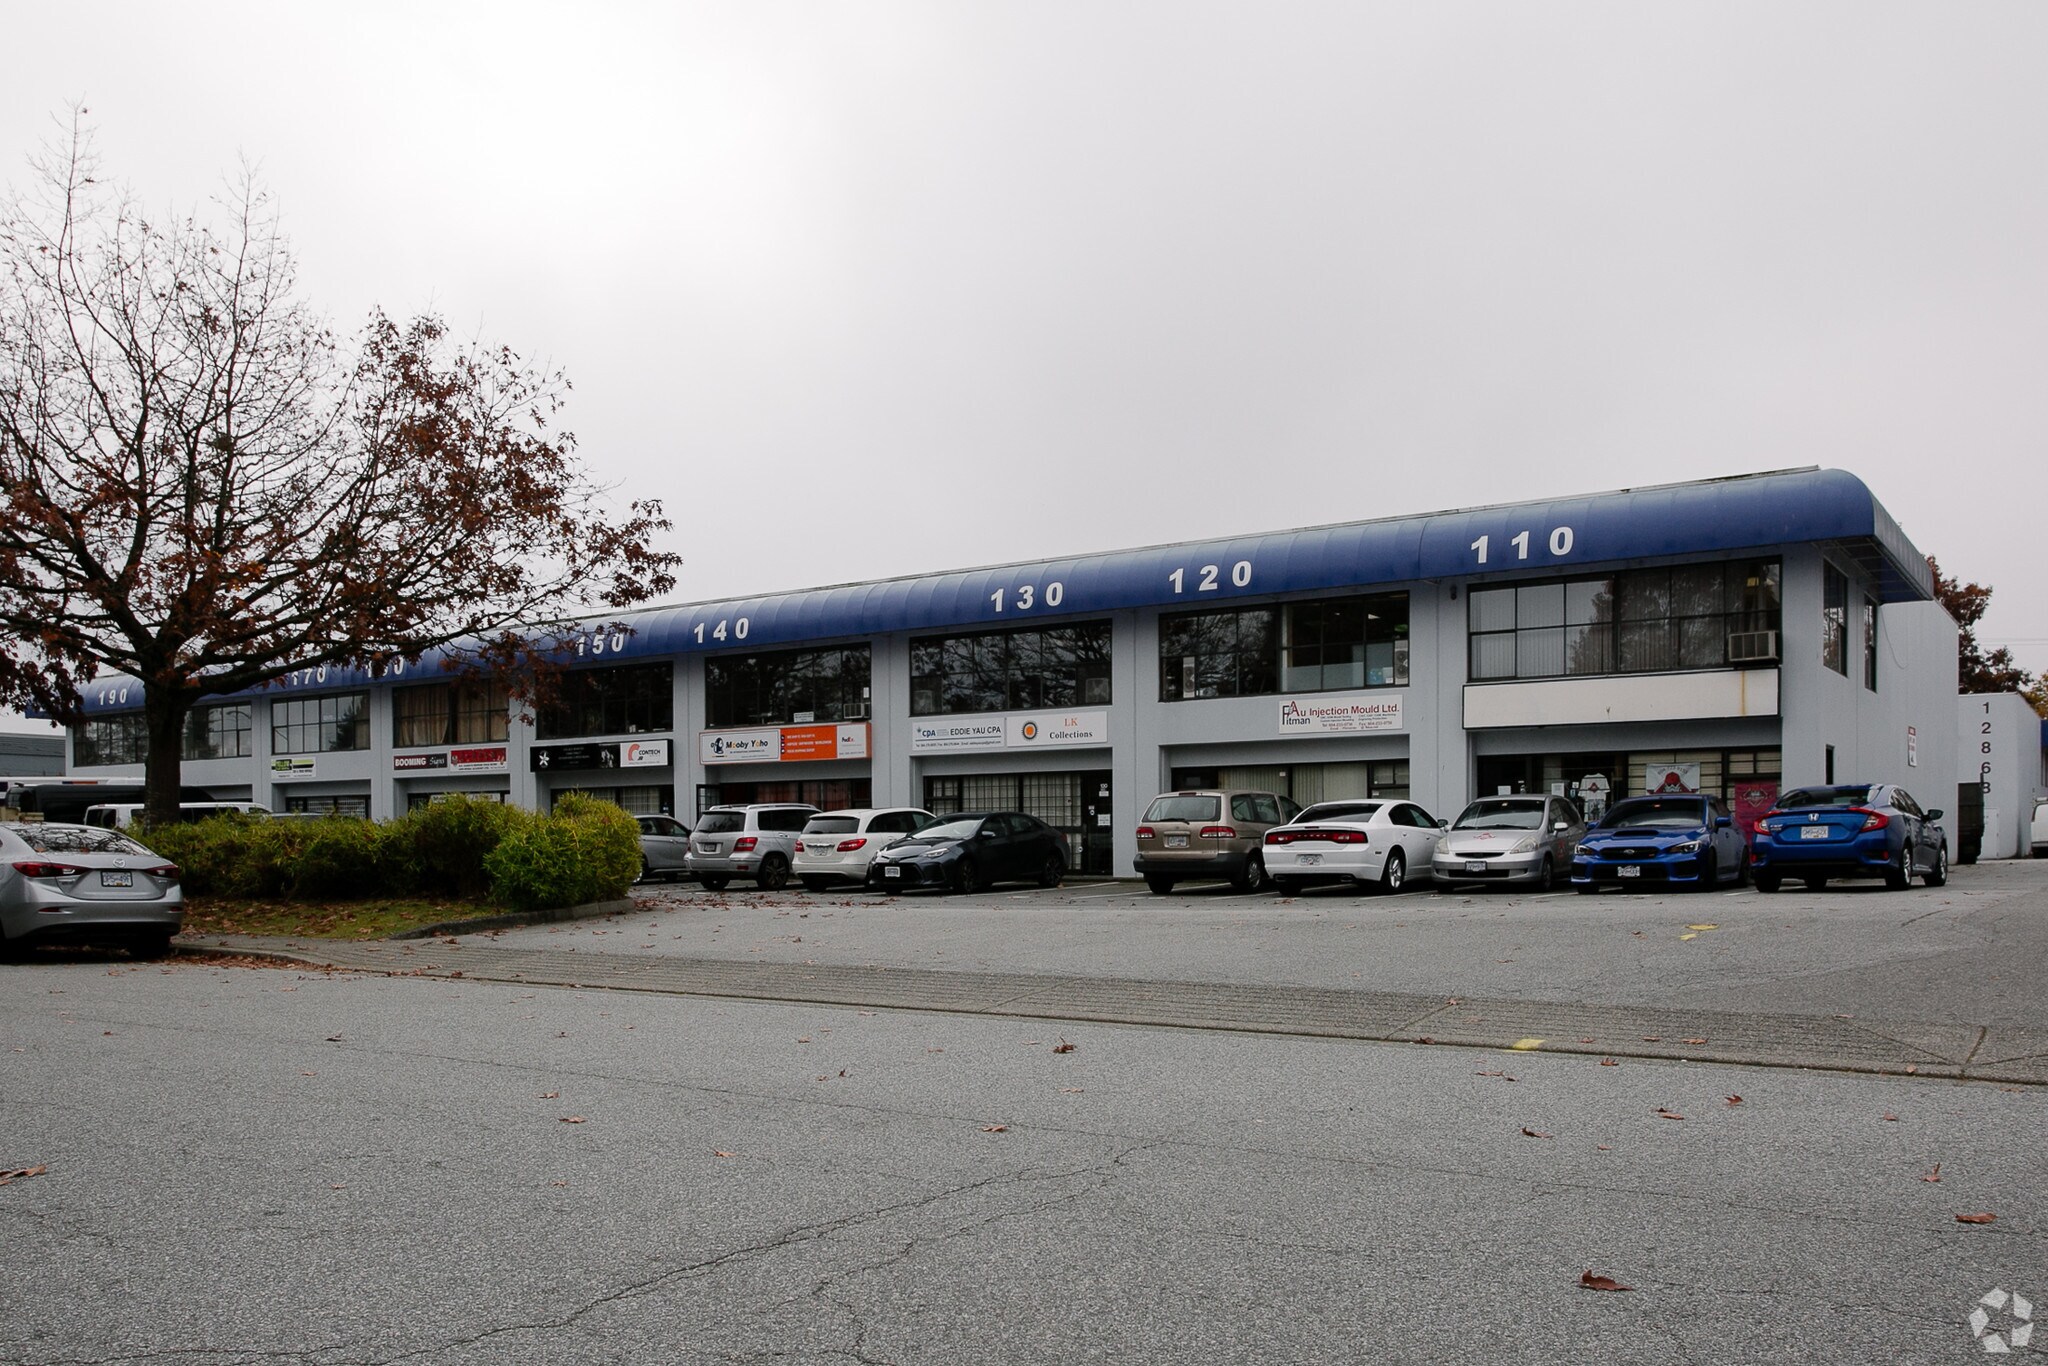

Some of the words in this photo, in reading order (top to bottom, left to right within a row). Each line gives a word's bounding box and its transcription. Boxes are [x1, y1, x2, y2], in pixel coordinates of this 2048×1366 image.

[1471, 526, 1574, 564] 110
[1168, 560, 1252, 594] 120
[991, 582, 1064, 612] 130
[694, 617, 749, 644] 140
[576, 633, 624, 656] 150
[291, 663, 326, 685] 170
[366, 655, 404, 678] 10
[99, 688, 127, 706] 190
[1309, 707, 1348, 718] Injection
[1351, 705, 1379, 715] Mould
[1382, 704, 1400, 713] Ltd.
[950, 728, 970, 736] EDDIE
[972, 727, 985, 735] YAU
[987, 726, 1001, 734] CPA
[1064, 718, 1078, 727] LK
[1049, 730, 1093, 739] Collections
[395, 757, 427, 767] BOOMING
